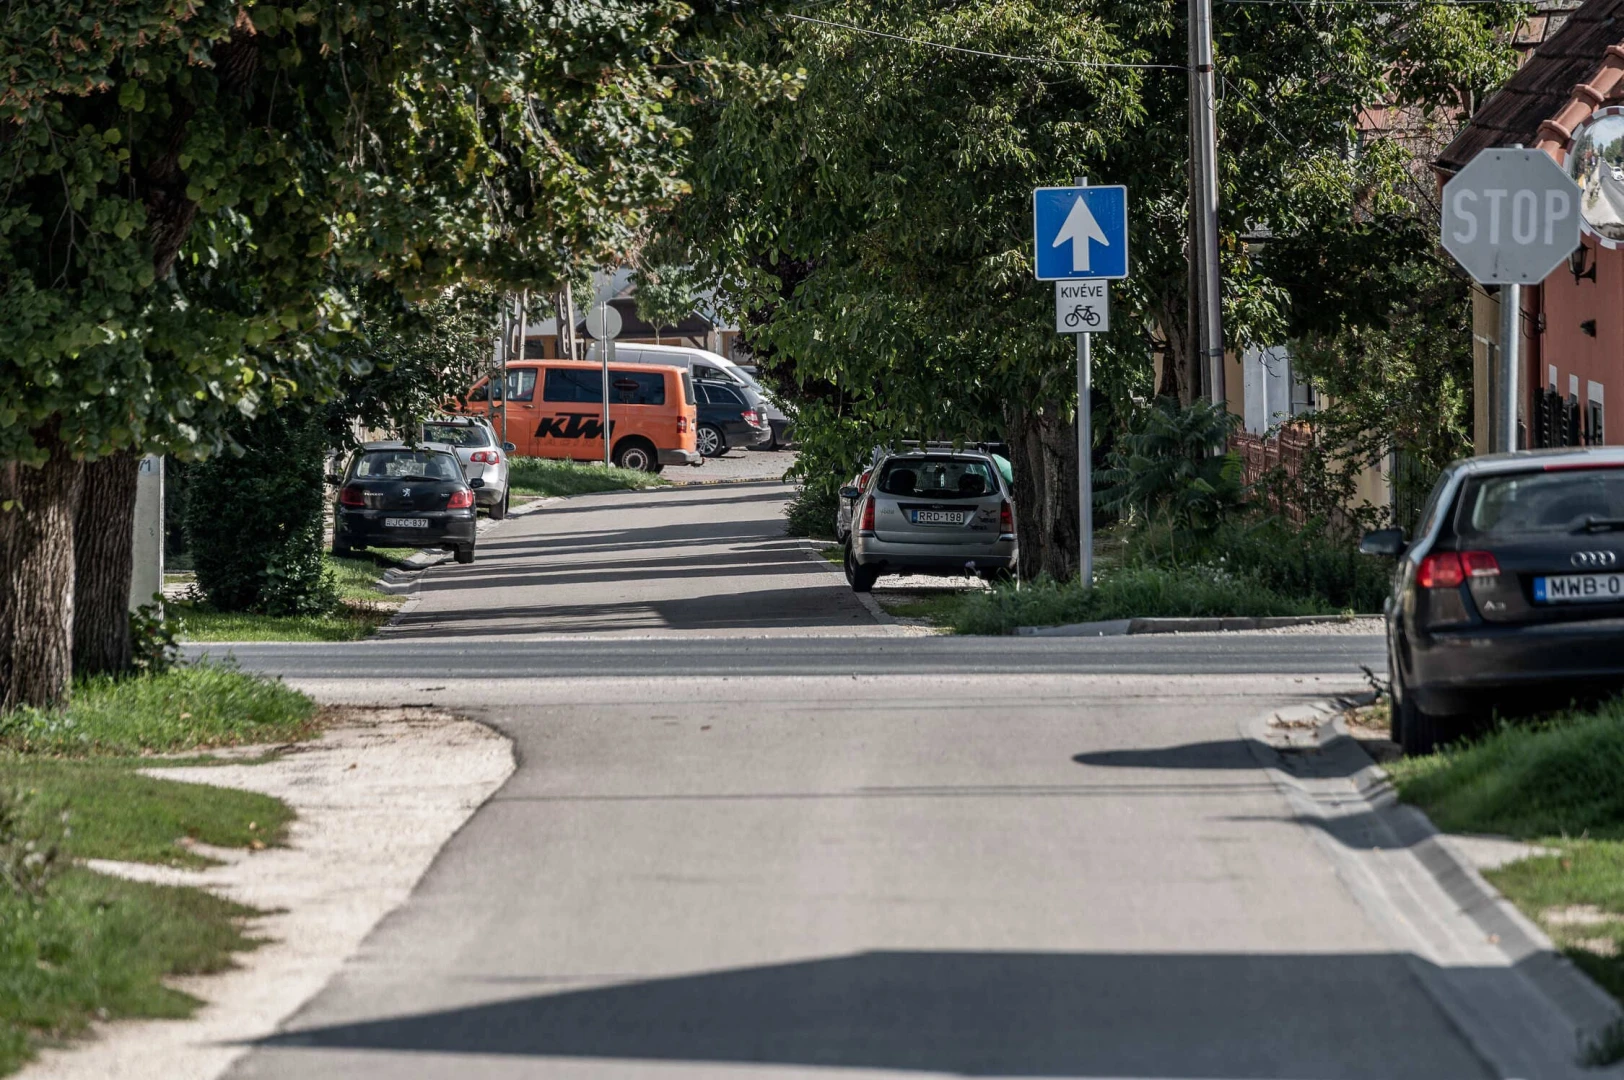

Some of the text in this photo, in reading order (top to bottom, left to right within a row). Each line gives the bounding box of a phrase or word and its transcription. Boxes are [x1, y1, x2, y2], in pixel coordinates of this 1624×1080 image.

[1452, 188, 1571, 245] STOP
[1061, 283, 1103, 298] KIVÉVE
[534, 411, 616, 439] KTM
[392, 519, 427, 527] JCC-837
[919, 511, 962, 522] RRD-198
[1550, 576, 1620, 596] MWB-0
